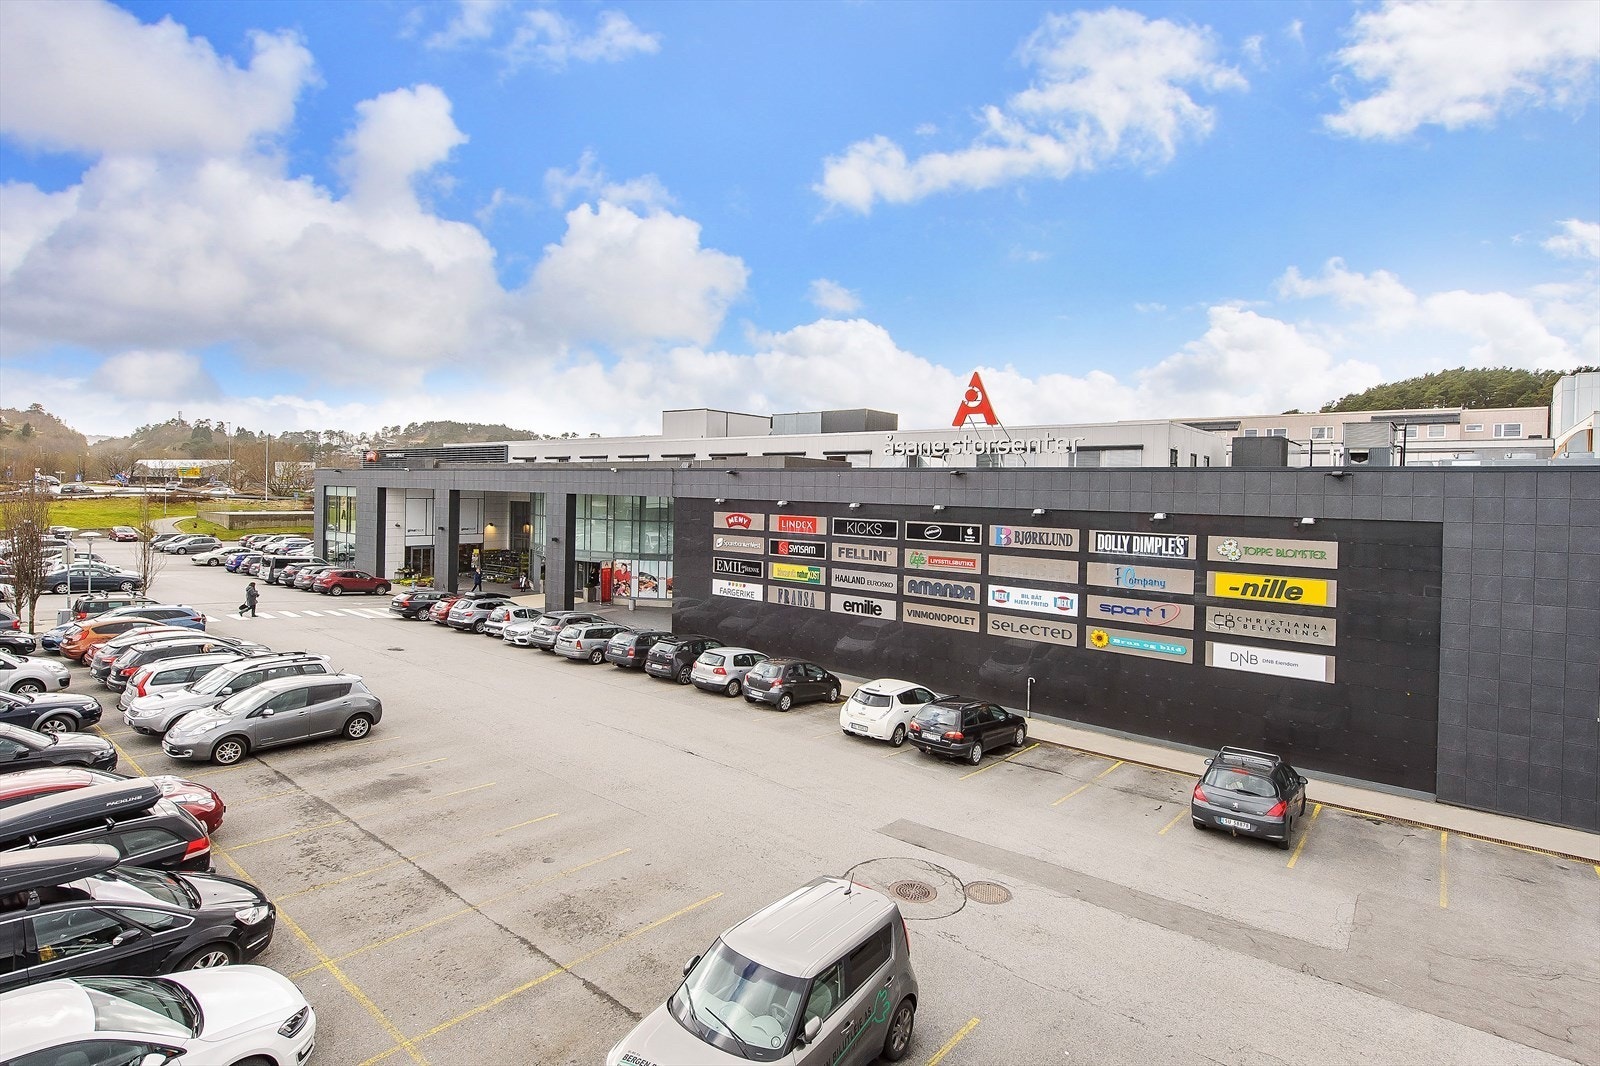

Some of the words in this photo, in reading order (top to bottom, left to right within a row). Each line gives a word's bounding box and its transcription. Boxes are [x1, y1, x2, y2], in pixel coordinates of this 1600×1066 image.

[952, 432, 1085, 456] storsenter
[728, 515, 748, 525] MENY
[781, 520, 813, 529] LINDEX
[846, 521, 883, 536] KICKS
[1014, 530, 1073, 547] BJØRKLUND
[1097, 533, 1130, 554] DOLLY
[838, 546, 887, 562] FELLINI
[1243, 546, 1274, 557] TOPPE
[1276, 548, 1327, 560] BLOMSTER
[716, 559, 745, 574] EMIL
[834, 573, 866, 585] HAALAND
[867, 580, 894, 588] EUROSKO
[719, 587, 755, 599] FARGERIKE
[777, 588, 815, 608] FRANSA
[908, 579, 976, 601] AMANDA
[1031, 593, 1042, 601] BÅT
[843, 599, 882, 617] emilie
[1099, 603, 1153, 617] sport
[1160, 608, 1166, 619] 1
[906, 608, 976, 626] VINMONOPOLET
[1237, 616, 1327, 632] CHRISTIANIA
[1242, 623, 1320, 638] BELYSNING
[1230, 650, 1259, 667] DNB
